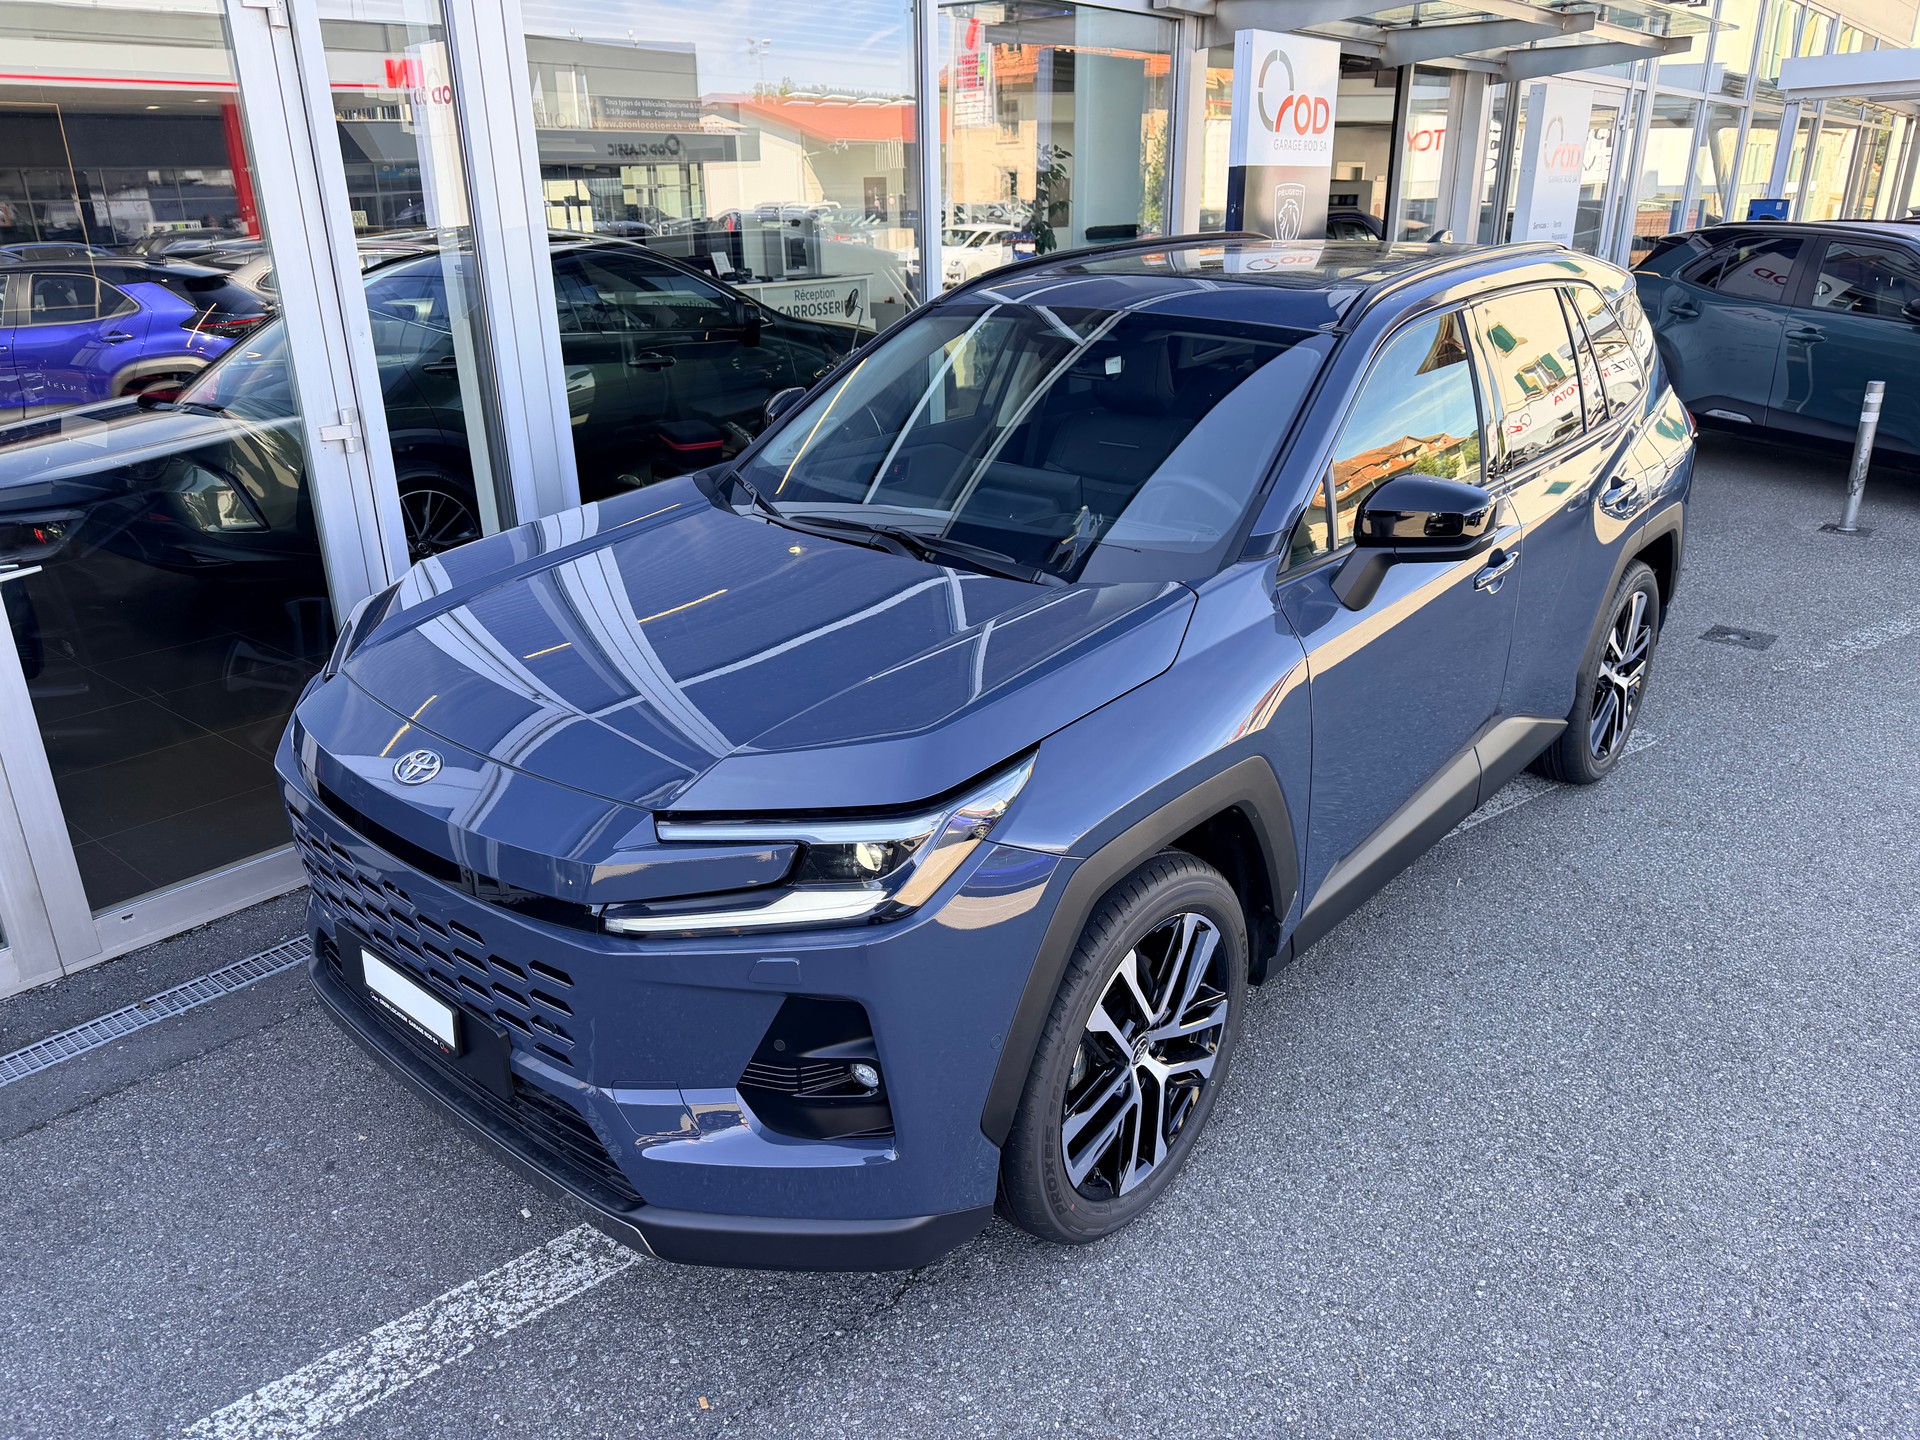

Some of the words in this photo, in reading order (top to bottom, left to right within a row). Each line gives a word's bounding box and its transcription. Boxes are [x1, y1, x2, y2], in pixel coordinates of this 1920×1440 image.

[1273, 138, 1302, 151] GARAGE
[1303, 140, 1318, 152] ROD
[1277, 188, 1303, 197] PEUGEOT
[794, 288, 836, 302] Réception
[1043, 1124, 1068, 1216] PROXES
